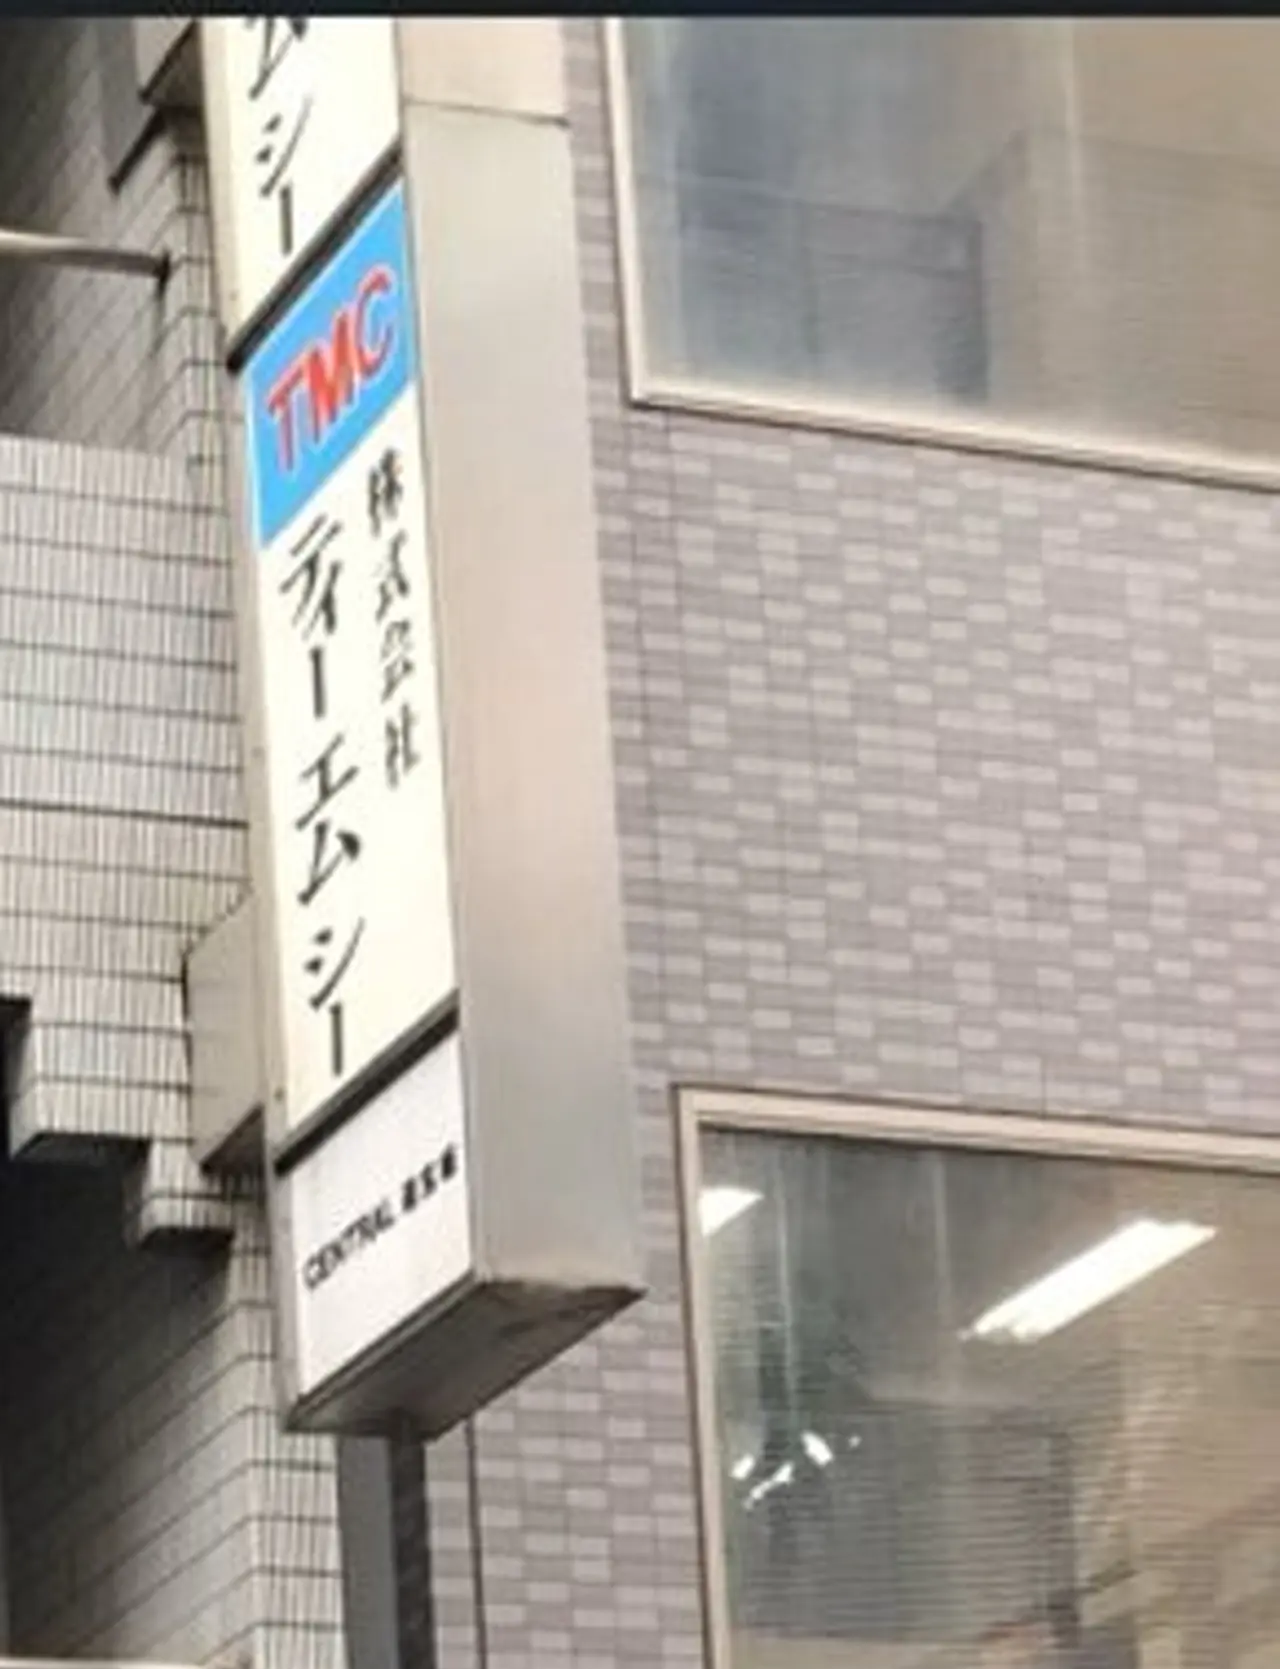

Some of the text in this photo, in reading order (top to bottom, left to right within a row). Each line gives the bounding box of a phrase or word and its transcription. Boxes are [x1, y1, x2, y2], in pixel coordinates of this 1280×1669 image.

[246, 17, 313, 256] ムシー
[266, 268, 396, 474] TMC
[368, 448, 419, 789] 株式会社
[278, 513, 366, 1076] ティーエムシー
[302, 1196, 397, 1292] CENTRAL
